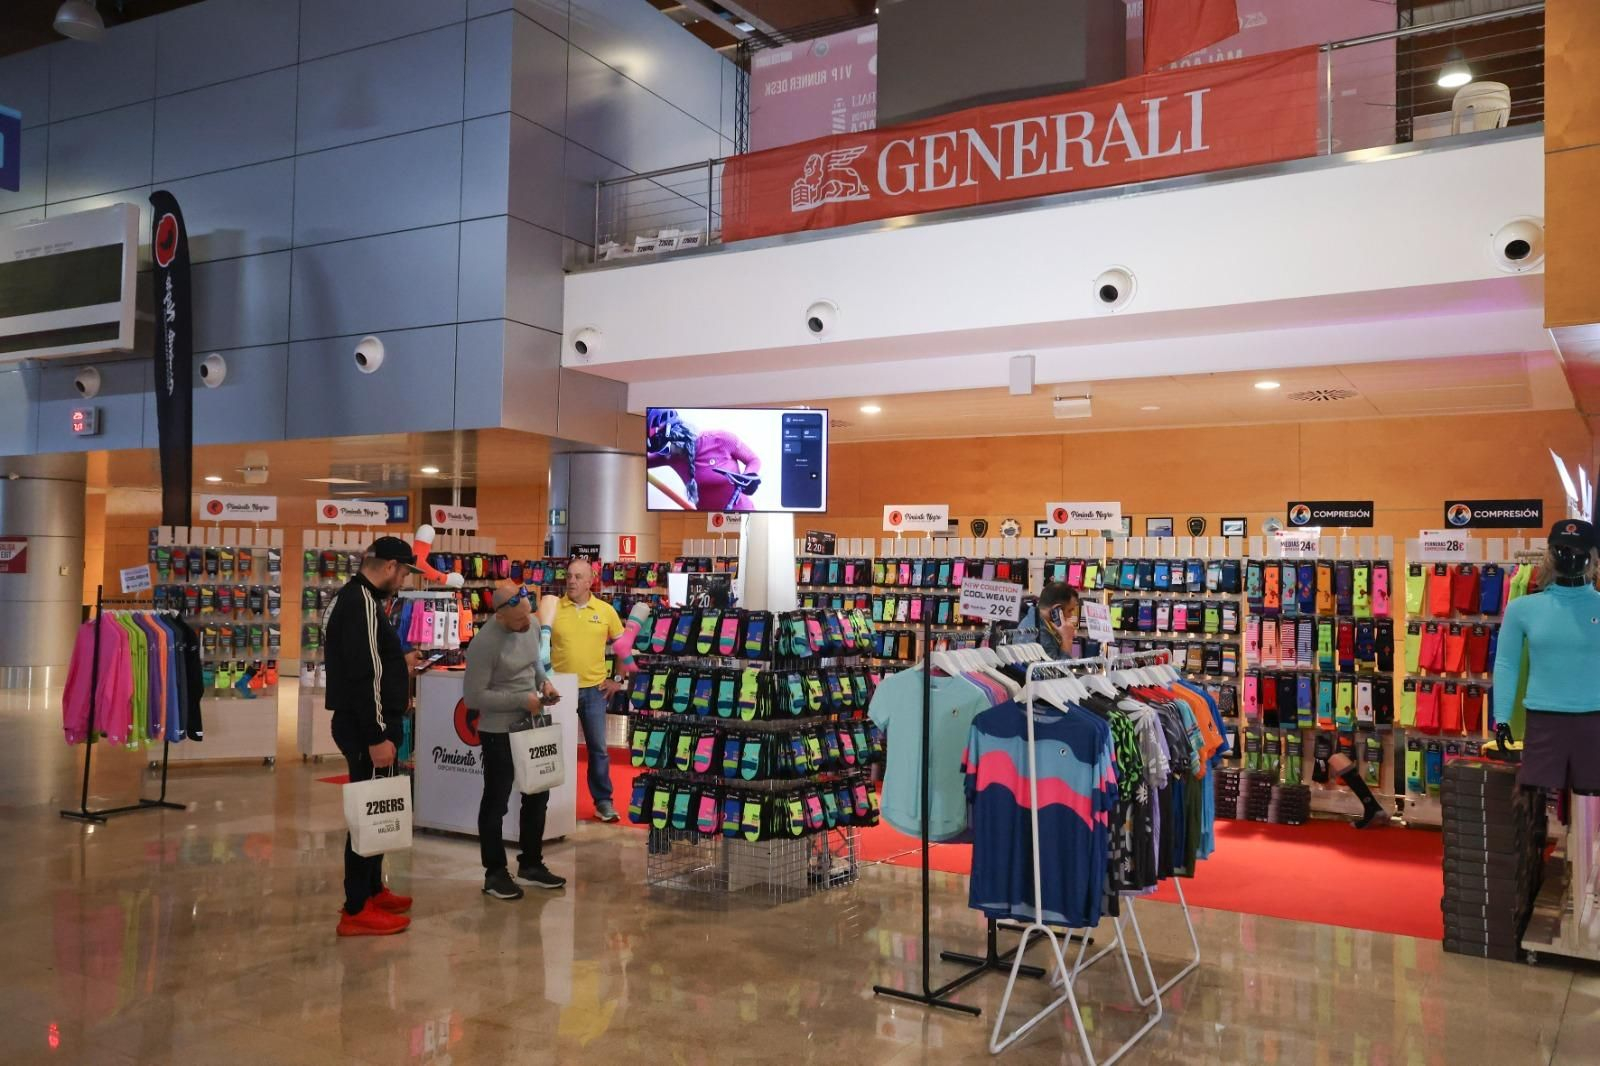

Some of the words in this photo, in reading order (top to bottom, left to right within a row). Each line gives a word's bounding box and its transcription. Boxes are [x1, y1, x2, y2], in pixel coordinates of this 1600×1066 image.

[876, 88, 1212, 196] GENERALI
[1313, 508, 1370, 518] COMPRESIÓN
[1473, 508, 1539, 518] COMPRESIÓN
[1446, 540, 1465, 552] 28€
[964, 582, 979, 590] NEW
[980, 584, 1018, 593] COLLECTION
[989, 604, 1013, 617] 29€
[432, 746, 476, 767] Pimiento
[528, 743, 558, 760] 226ERS
[366, 797, 405, 816] 226ERS
